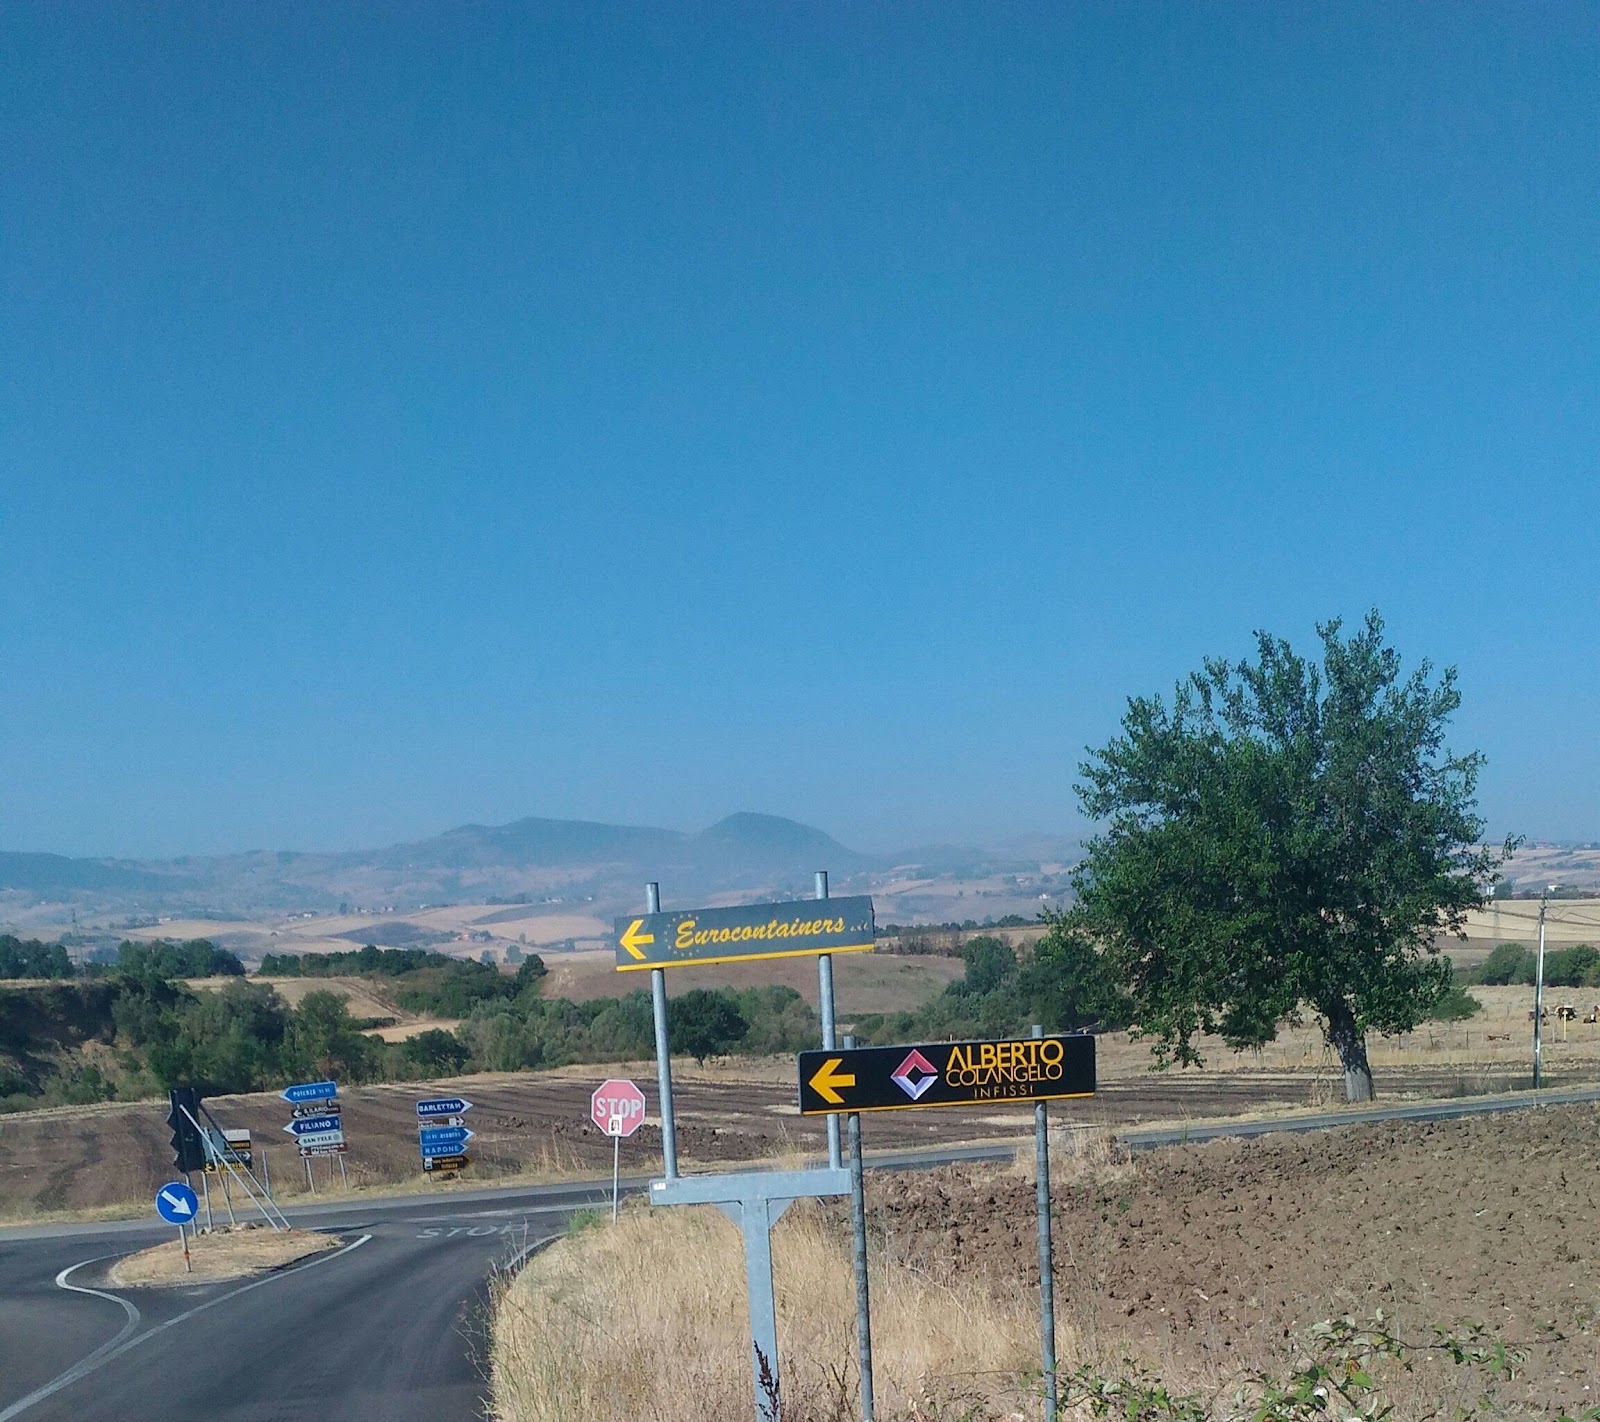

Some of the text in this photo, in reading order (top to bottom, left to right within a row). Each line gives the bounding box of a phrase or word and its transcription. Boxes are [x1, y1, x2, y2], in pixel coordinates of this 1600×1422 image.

[674, 916, 846, 949] Eurocontainers
[946, 1039, 1064, 1071] ALBERTO
[946, 1062, 1063, 1087] COLANGELO
[974, 1084, 1033, 1099] INFISSI
[596, 1097, 642, 1119] STOP
[300, 1120, 331, 1131] FILIANO
[425, 1145, 459, 1154] RAPONE
[416, 1223, 529, 1238] STOP
